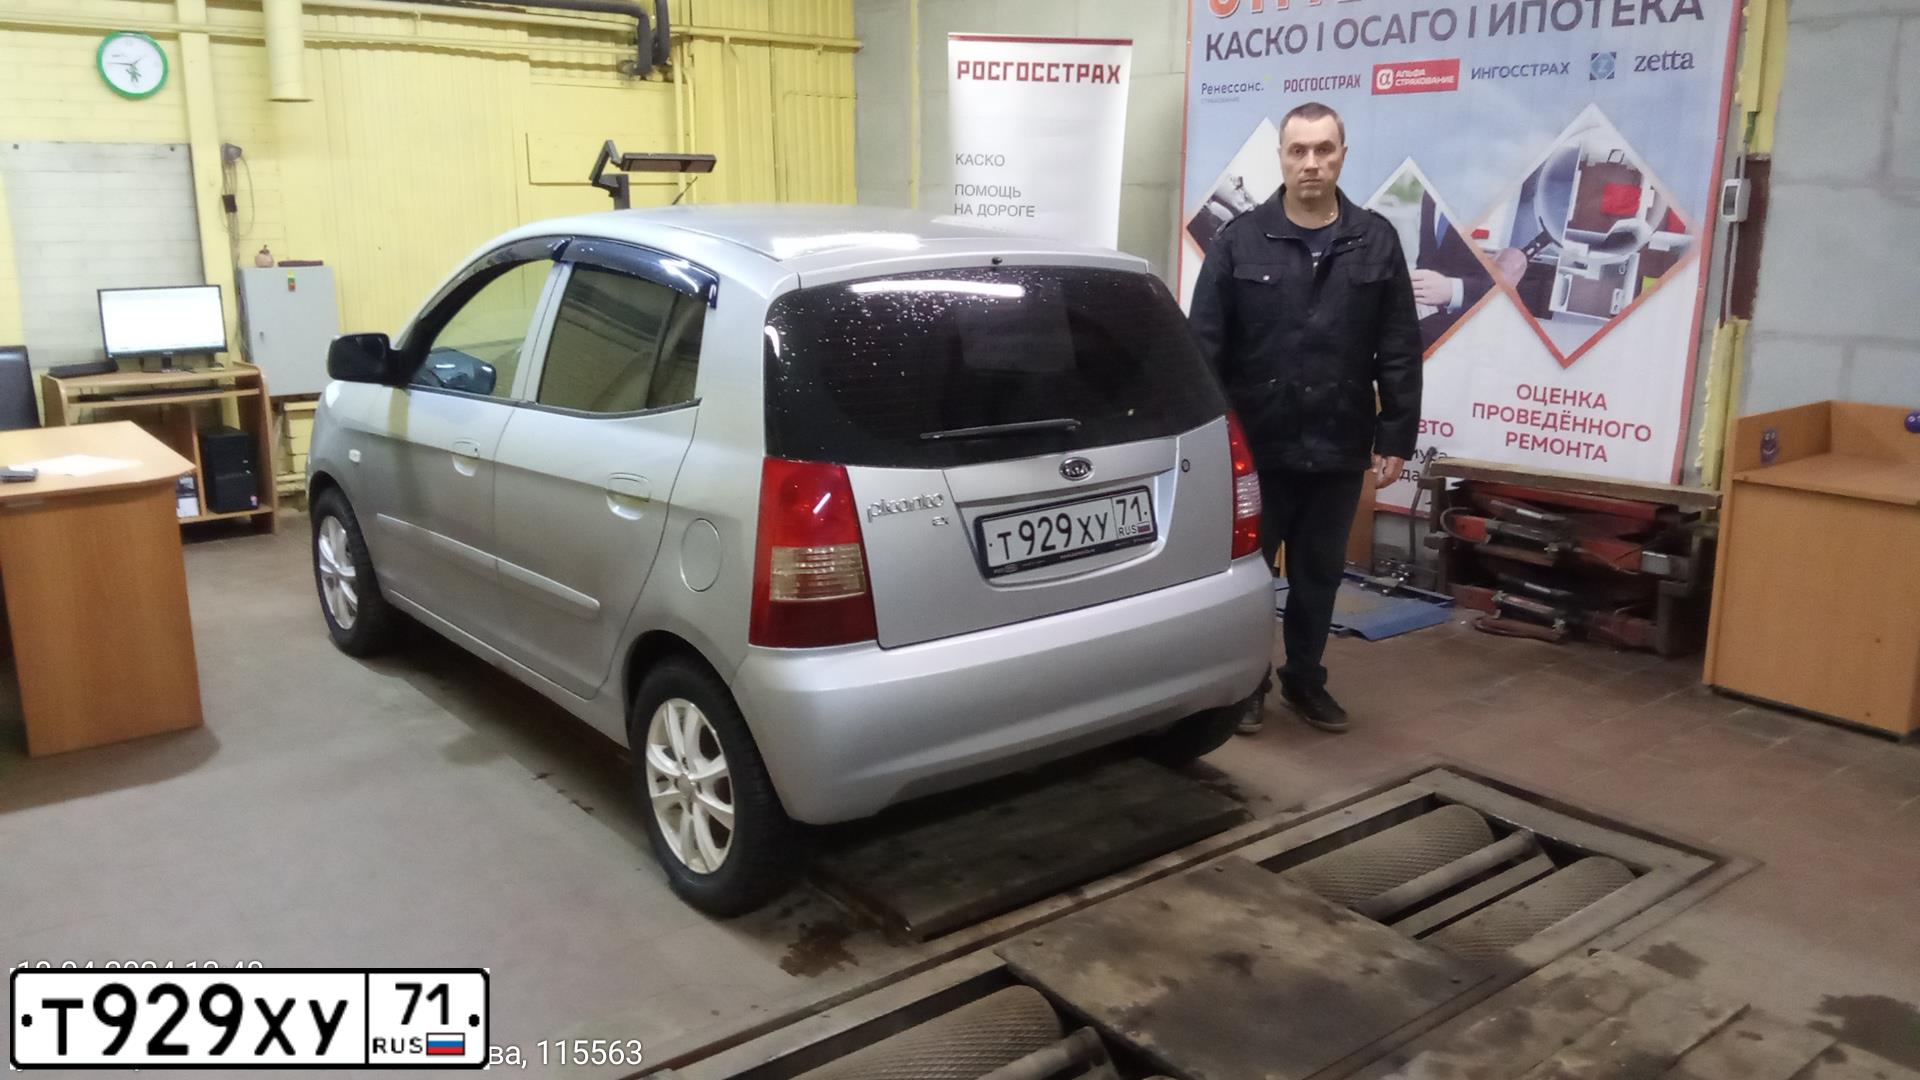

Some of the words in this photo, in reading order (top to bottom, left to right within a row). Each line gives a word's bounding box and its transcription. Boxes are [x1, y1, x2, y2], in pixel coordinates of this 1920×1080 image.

[1205, 23, 1308, 61] КАСКО
[1333, 8, 1457, 49] ОСАГО
[1488, 0, 1704, 36] ИПОТЕКА
[1471, 62, 1570, 80] ИНГОССТРАХ
[1634, 49, 1695, 73] zetta
[957, 61, 1121, 84] РОСГОССТРАХ
[1283, 74, 1361, 93] РОСГОССТРАХ
[955, 153, 1006, 167] КАСКО
[954, 184, 1022, 199] ПОМОЩЬ
[954, 203, 973, 216] НА
[977, 204, 1035, 217] ДОРОГЕ
[1516, 384, 1608, 411] ОЦЕНКА
[1417, 419, 1454, 438] ВТО
[1472, 403, 1651, 442] ПРОВЕДЁННОГО
[1505, 431, 1608, 463] РЕМОНТА
[1115, 495, 1142, 526] 71
[1118, 525, 1137, 535] RUS
